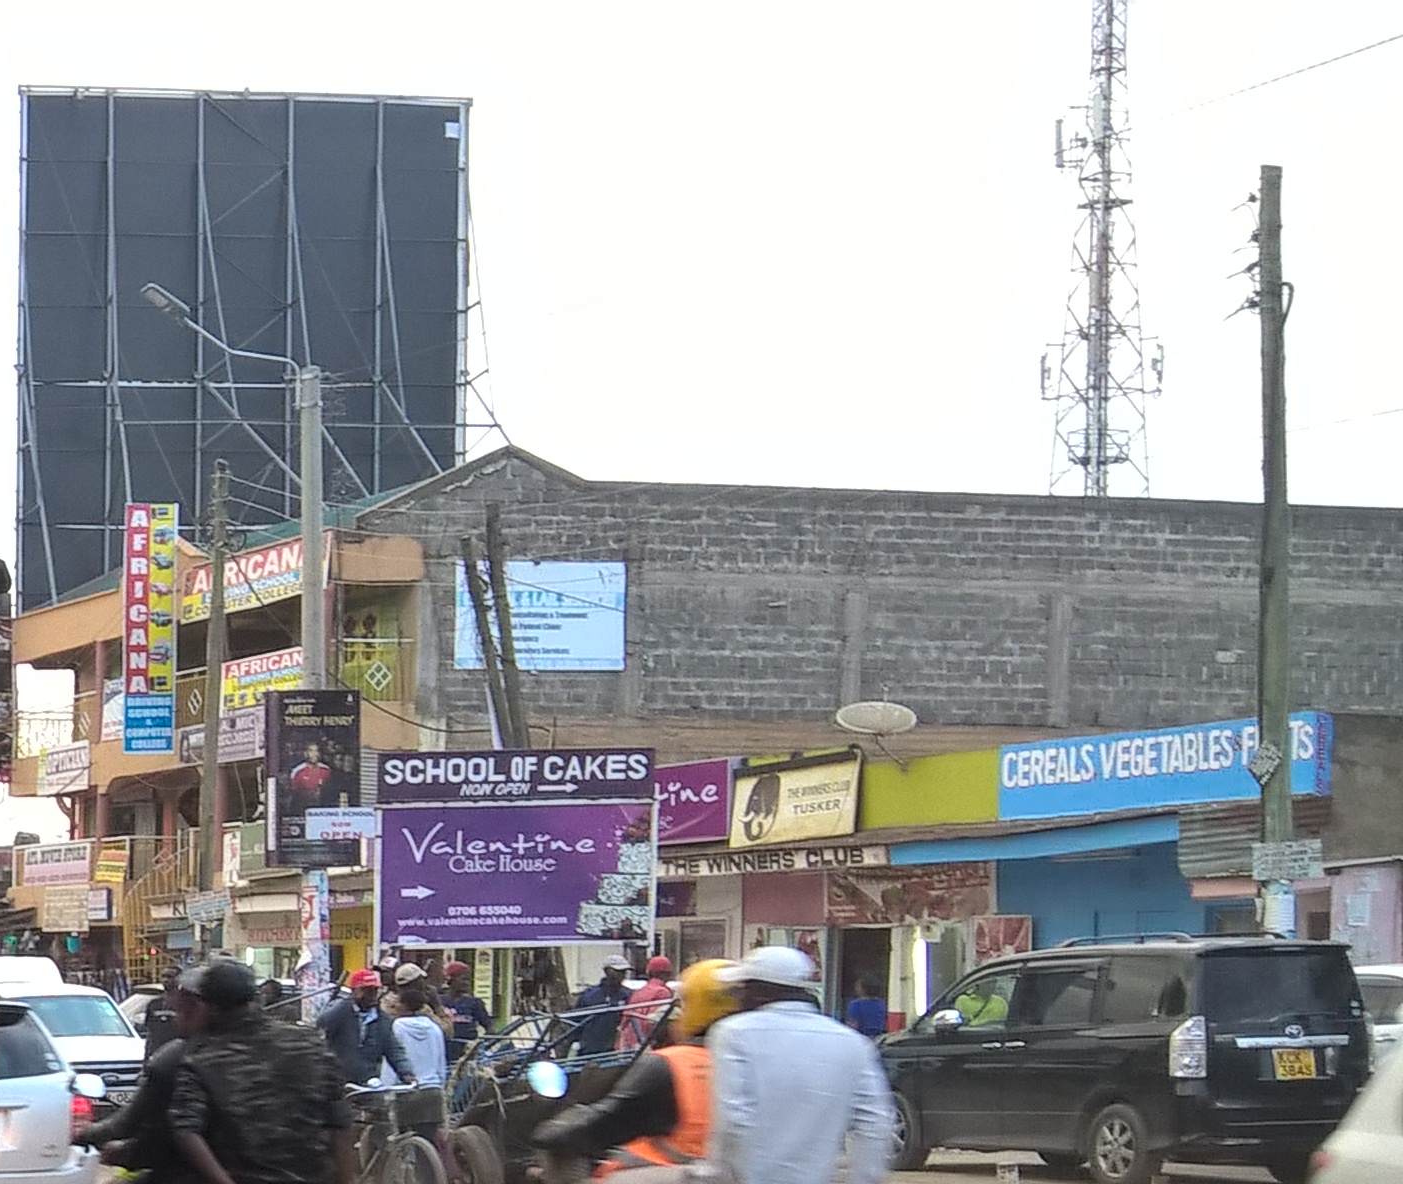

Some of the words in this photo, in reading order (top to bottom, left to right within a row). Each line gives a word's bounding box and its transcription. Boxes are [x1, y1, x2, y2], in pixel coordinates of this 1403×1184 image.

[192, 542, 304, 595] ARICAN
[129, 510, 150, 693] AFRICANA
[227, 652, 304, 678] AFRICAN
[1097, 728, 1234, 779] VEGETABLES
[384, 756, 505, 785] SCHOOL
[510, 756, 538, 781] OF
[543, 753, 649, 782] CAKES
[460, 783, 492, 796] NOW
[494, 782, 531, 795] OPEN
[793, 798, 841, 815] TUSKER
[320, 831, 363, 840] OPEN
[401, 821, 596, 864] Valentine
[448, 855, 495, 873] Cake
[499, 856, 557, 872] House
[661, 856, 702, 876] THE
[706, 850, 796, 874] WINNERS
[805, 846, 866, 868] CLUB
[397, 915, 568, 928] www.valentinecakehouse.com
[447, 906, 477, 917] 0706
